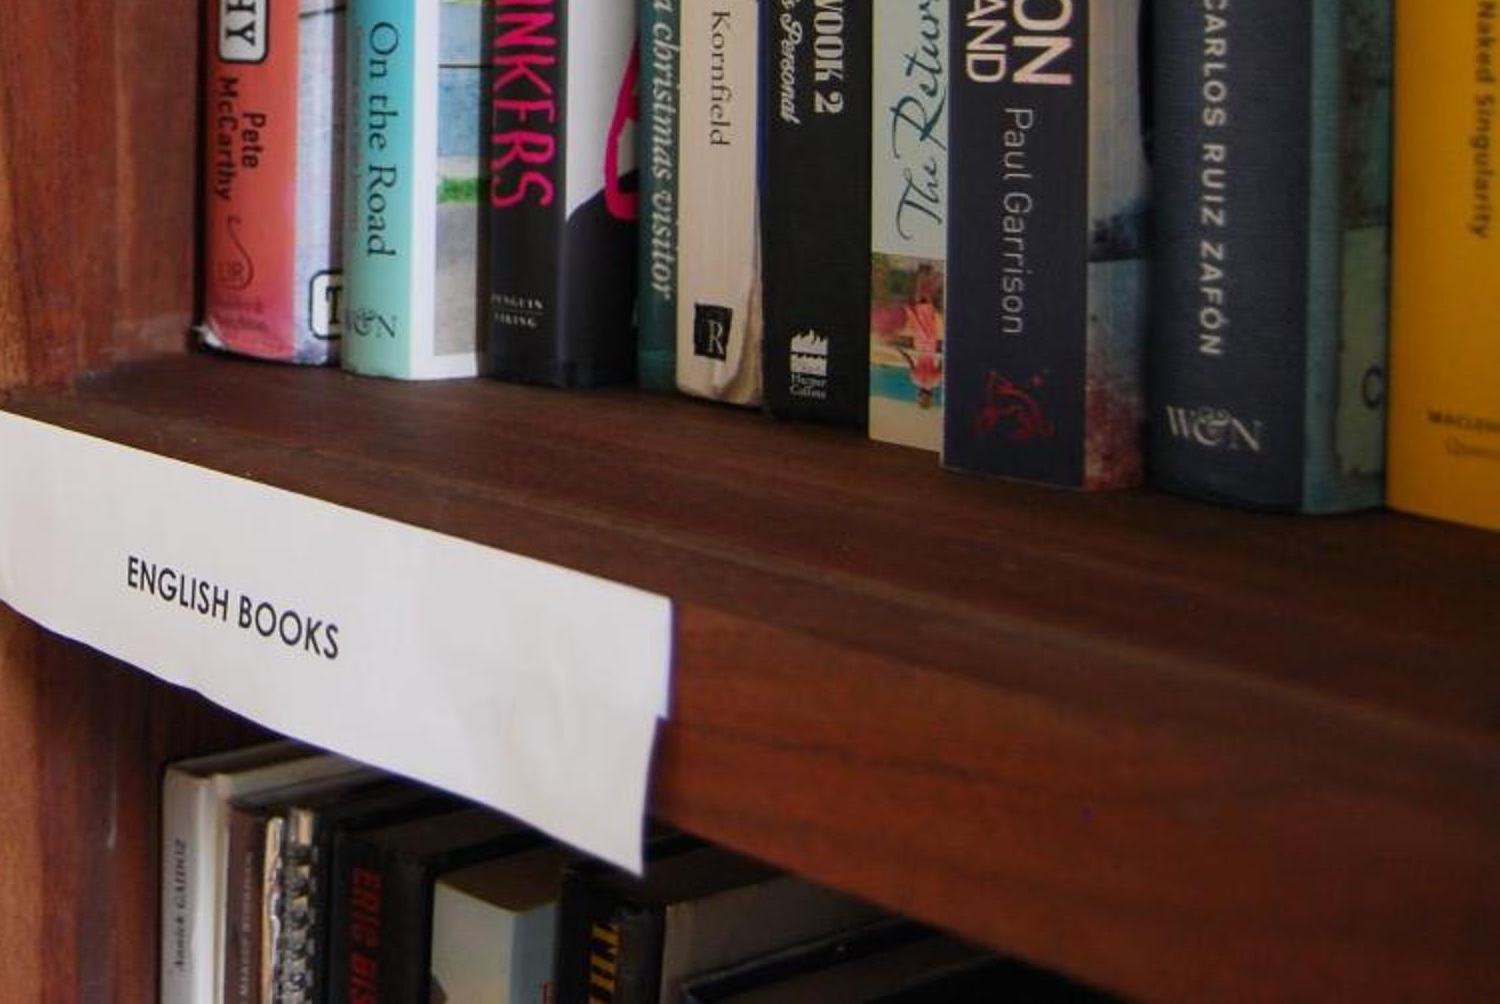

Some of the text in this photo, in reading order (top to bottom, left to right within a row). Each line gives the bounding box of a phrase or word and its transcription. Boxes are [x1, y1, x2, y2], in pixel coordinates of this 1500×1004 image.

[652, 22, 680, 181] christmas
[708, 12, 734, 146] Kornfield
[780, 13, 802, 125] Personal
[814, 90, 844, 113] 2
[212, 75, 240, 202] McCarthy
[241, 112, 267, 169] Pete
[367, 21, 399, 257] On the Road
[1201, 143, 1227, 228] RUIZ
[651, 190, 678, 300] visitor
[896, 159, 944, 241] The
[1001, 107, 1033, 335] Paul Garrison
[1199, 241, 1229, 356] ZAFÓN
[126, 555, 339, 660] ENGLISH BOOKS
